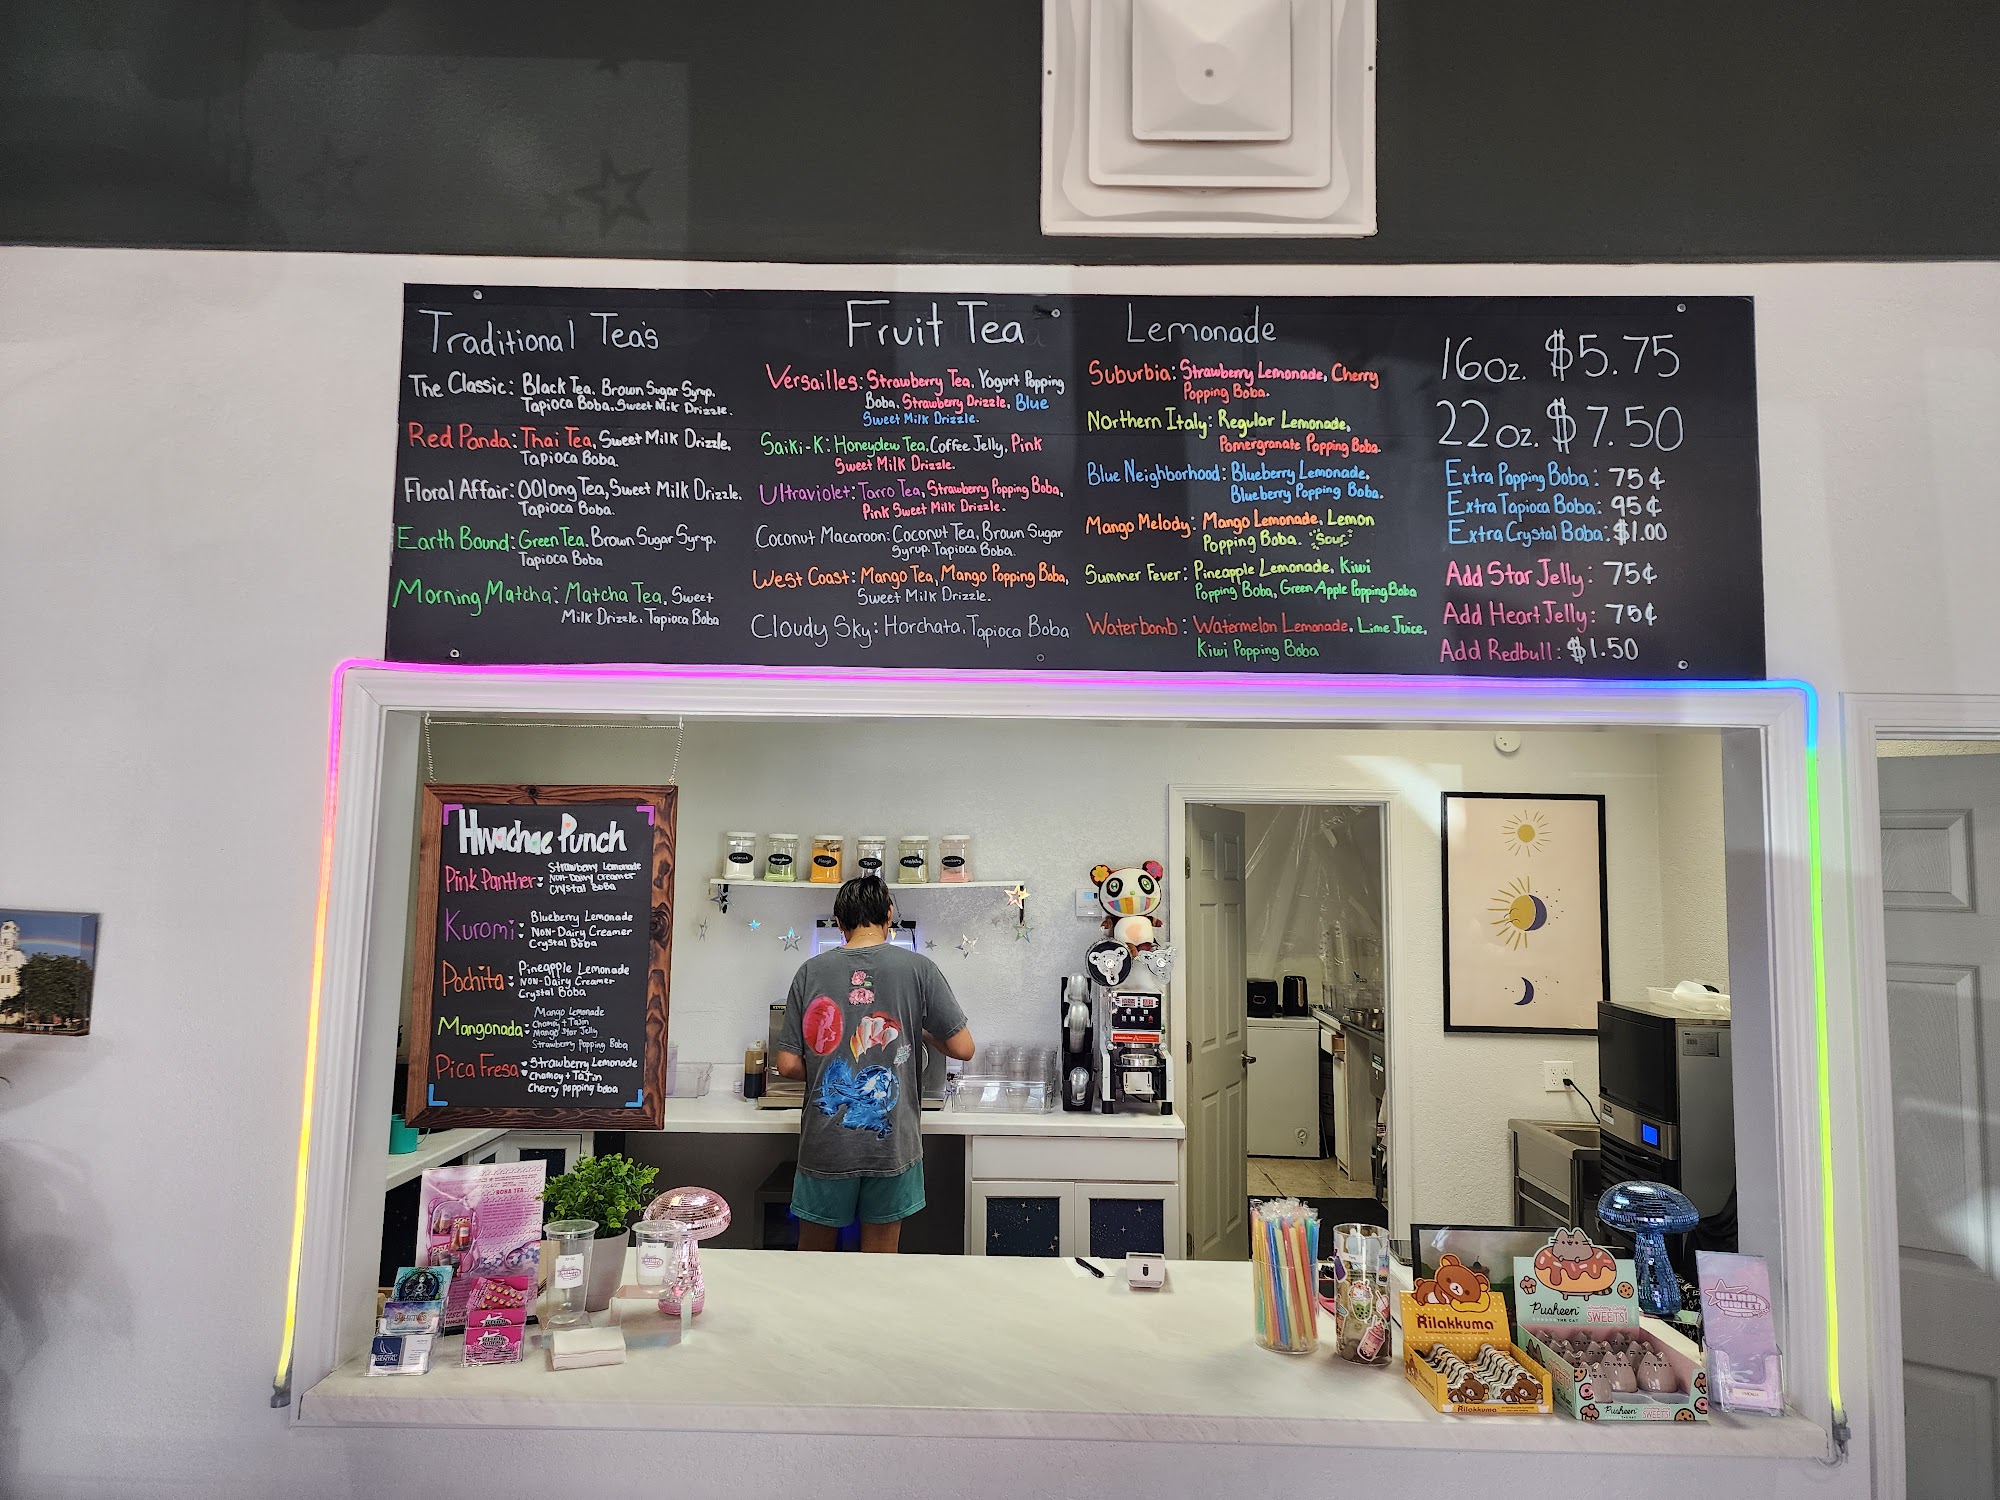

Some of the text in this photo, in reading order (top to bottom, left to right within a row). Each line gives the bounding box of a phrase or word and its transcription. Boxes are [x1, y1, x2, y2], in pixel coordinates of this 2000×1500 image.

[419, 309, 659, 357] Traditional Tea's
[847, 300, 1024, 348] Fruit Tea
[1127, 302, 1276, 343] Lemonade
[1545, 328, 1680, 381] $5.75
[766, 364, 863, 391] Versailles:
[866, 368, 943, 396] Strawberry
[978, 368, 1020, 393] Yogurt
[1025, 370, 1065, 394] Popping
[1089, 360, 1176, 386] Suburbia:
[1180, 358, 1254, 386] Strawberry
[1331, 363, 1380, 389] Cherry
[408, 374, 444, 398] The
[448, 371, 514, 396] Classic:
[522, 373, 565, 396] Black
[602, 378, 644, 397] Brown
[647, 380, 678, 400] Sugar
[681, 380, 715, 404] Syrup.
[1184, 383, 1270, 404] Popping Boba.
[902, 394, 963, 414] Strawberry
[1015, 395, 1049, 411] Blue
[863, 411, 979, 427] Sweet Milk Drizzle.
[1436, 397, 1684, 454] 22oz. $7.50
[409, 422, 452, 448] Red
[459, 423, 517, 450] Panda:
[520, 426, 559, 448] Thai
[599, 430, 642, 447] Sweet
[646, 431, 679, 446] Milk
[1087, 462, 1121, 486] Blue
[1124, 459, 1226, 488] Neighborhood:
[1231, 462, 1295, 485] Blueberry
[1445, 459, 1665, 491] Extra Popping Boba: 75¢
[1447, 490, 1662, 522] Extra Tapioca Boba: 95¢
[1448, 517, 1667, 547] Extra Crystal Boba: $1.00
[1446, 559, 1657, 598] Add Star Jelly: 75¢
[392, 578, 481, 616] Morning
[485, 579, 559, 606] Matcha:
[565, 581, 628, 606] Matcha
[671, 586, 714, 603] Sweet
[1086, 612, 1188, 636] Waterbomb:
[1193, 612, 1277, 634] Watermelon
[1357, 617, 1390, 635] Lime
[1443, 601, 1657, 633] Add Heart Jelly: 75¢
[751, 614, 829, 647] Cloudy
[833, 614, 879, 648] Sky:
[967, 614, 1021, 647] Tapioca
[1028, 614, 1069, 639] Boba
[1440, 636, 1639, 664] Add Redbull: $1.50
[459, 809, 627, 856] Hwachae Punch
[445, 865, 479, 892] Pink
[548, 862, 641, 873] Strawberry Lemonade
[549, 884, 586, 895] Crystal
[445, 908, 515, 942] Kuromi
[531, 910, 633, 927] Blueberry Lemonade
[589, 926, 632, 937] Creamer
[529, 938, 597, 951] Crystal Boba
[442, 960, 504, 996] Pochita
[518, 960, 630, 978] Pineapple Lemonade
[518, 986, 586, 1001] Crystal Boba
[575, 977, 615, 986] Creamer
[532, 1020, 561, 1031] Chamoy
[562, 1019, 567, 1027] +
[534, 1006, 604, 1022] Mango Lemonade
[437, 1016, 523, 1040] Mangonada
[533, 1028, 559, 1040] Mango
[580, 1026, 598, 1038] Jelly
[532, 1039, 575, 1051] Strawberry
[610, 1038, 628, 1051] Boba
[436, 1053, 519, 1080] Pica Fresa
[529, 1056, 638, 1073] Strawberry Lemonade
[529, 1071, 563, 1085] Chamoy
[565, 1071, 571, 1080] +
[528, 1083, 559, 1098] Cherry
[1529, 1302, 1579, 1315] Pusheen
[1715, 1292, 1757, 1302] ULTRA
[1417, 1313, 1494, 1329] Rilakkuma
[1588, 1311, 1627, 1323] SWEETS!
[1604, 1405, 1637, 1415] Pusheen
[1643, 1410, 1670, 1419] SWEETS!
